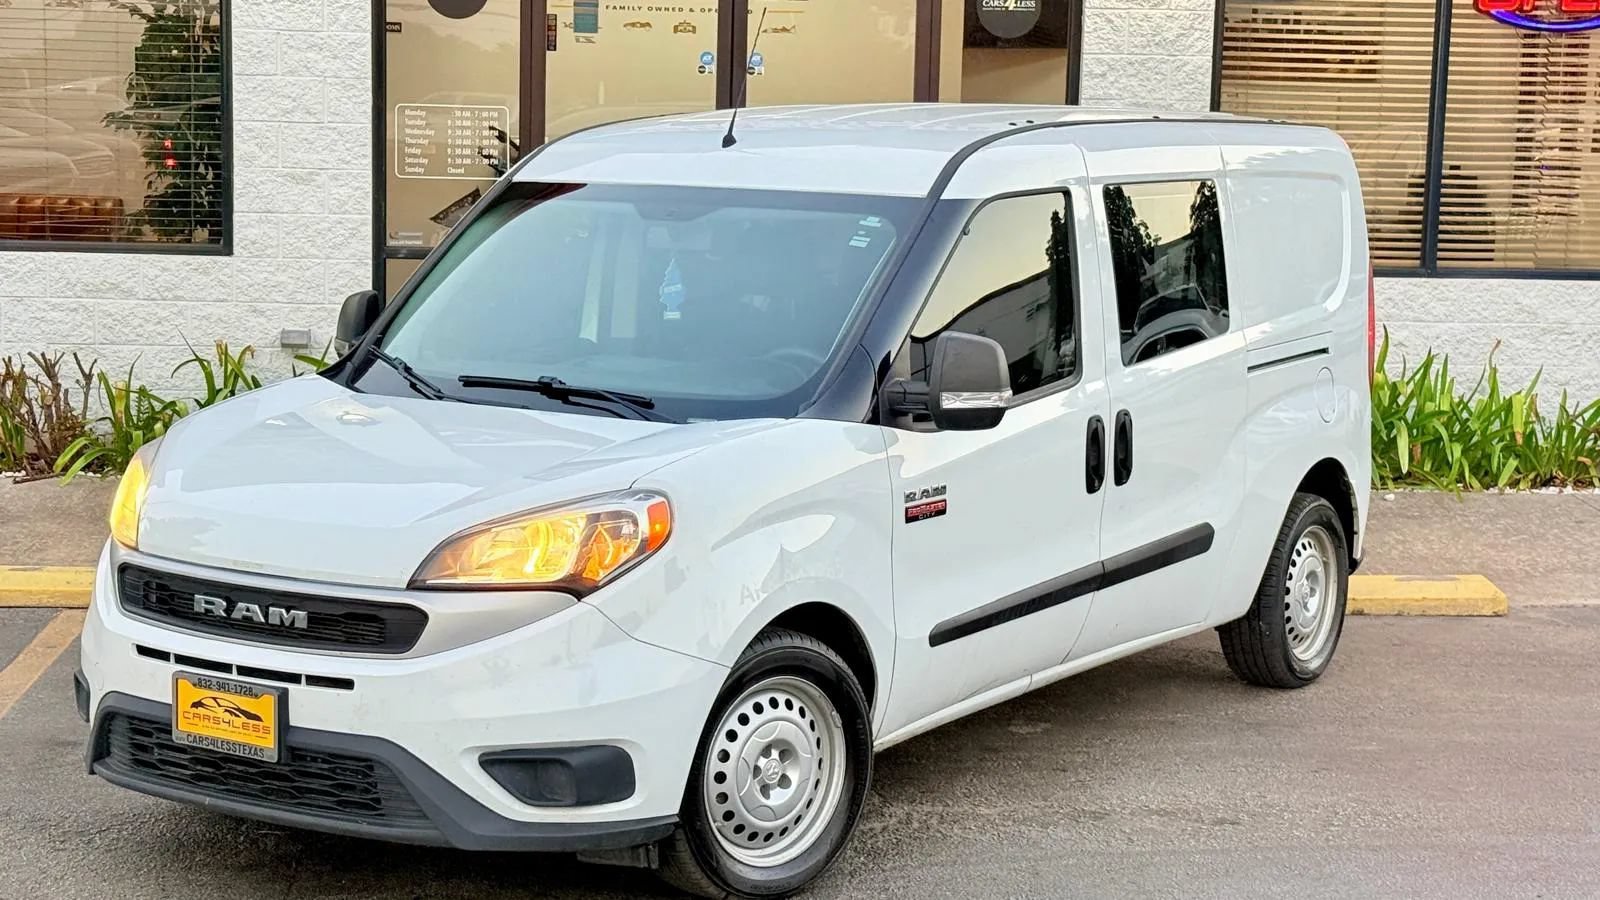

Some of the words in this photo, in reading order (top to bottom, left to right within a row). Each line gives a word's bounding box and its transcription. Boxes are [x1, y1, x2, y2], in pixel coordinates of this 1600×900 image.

[405, 109, 426, 117] Monday
[405, 118, 426, 127] Tuesday
[405, 146, 422, 155] Friday
[904, 483, 946, 503] RAM
[194, 594, 308, 629] RAM
[197, 678, 254, 696] 832-941-1728
[182, 711, 271, 735] CARS4LESS
[187, 734, 265, 758] CARS4LESSTEXAS
